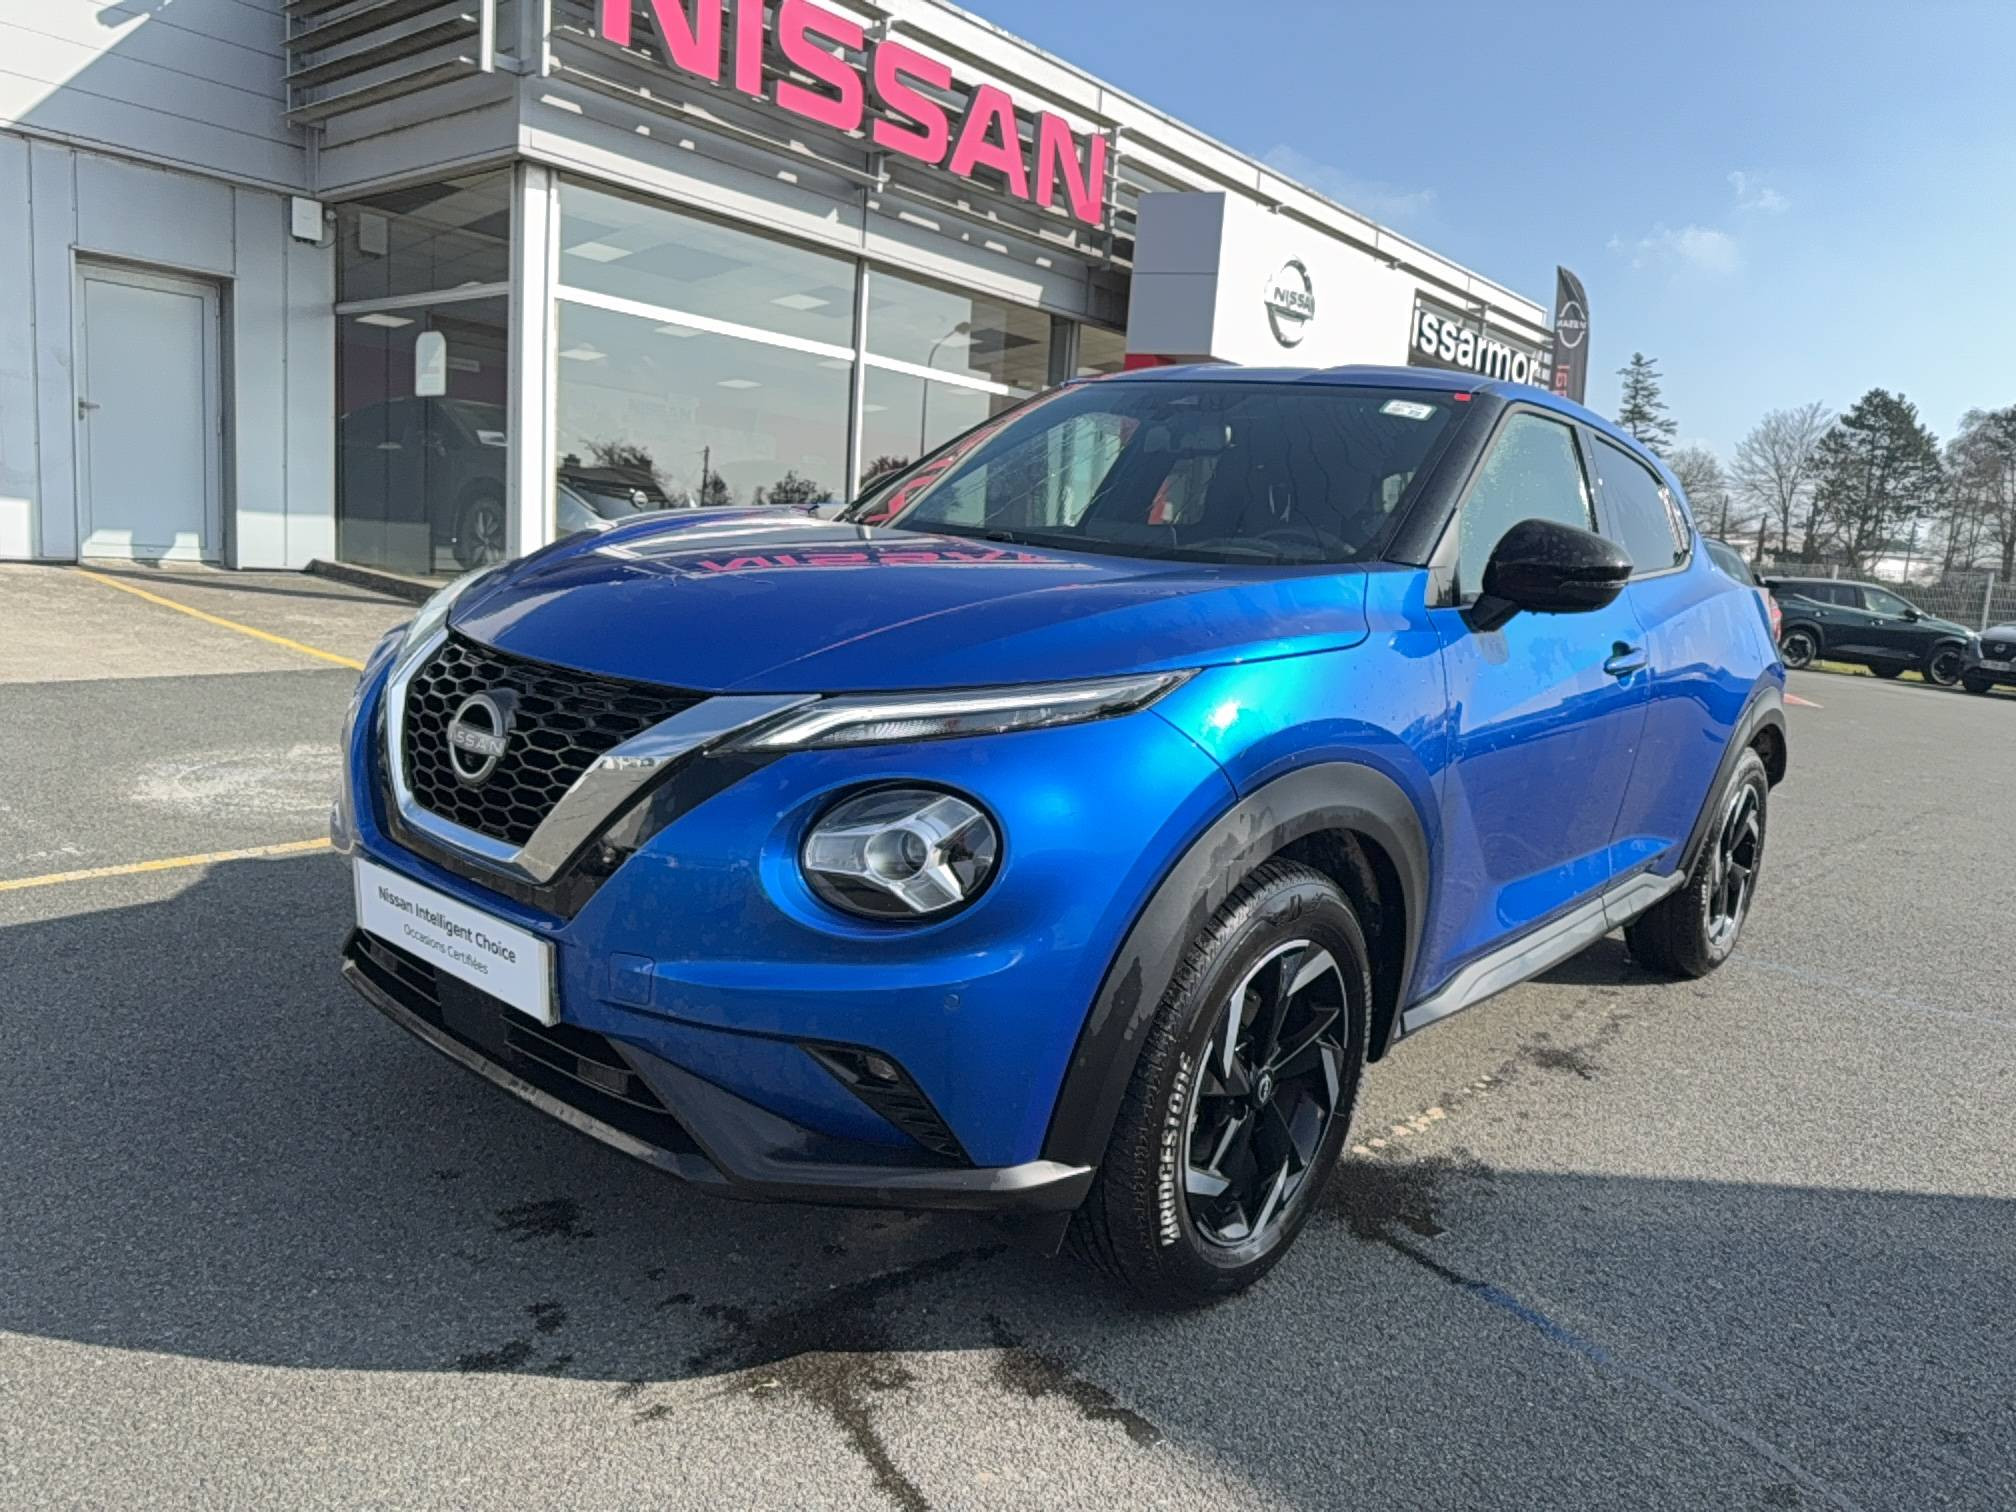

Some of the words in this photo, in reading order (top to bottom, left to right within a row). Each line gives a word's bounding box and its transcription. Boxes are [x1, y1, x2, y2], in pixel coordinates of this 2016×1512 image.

[378, 886, 414, 913] Nissan
[416, 904, 473, 943] Intelligent
[475, 931, 516, 964] Choice
[404, 924, 447, 954] Occasions
[1159, 1051, 1193, 1247] BRIDGESTONE
